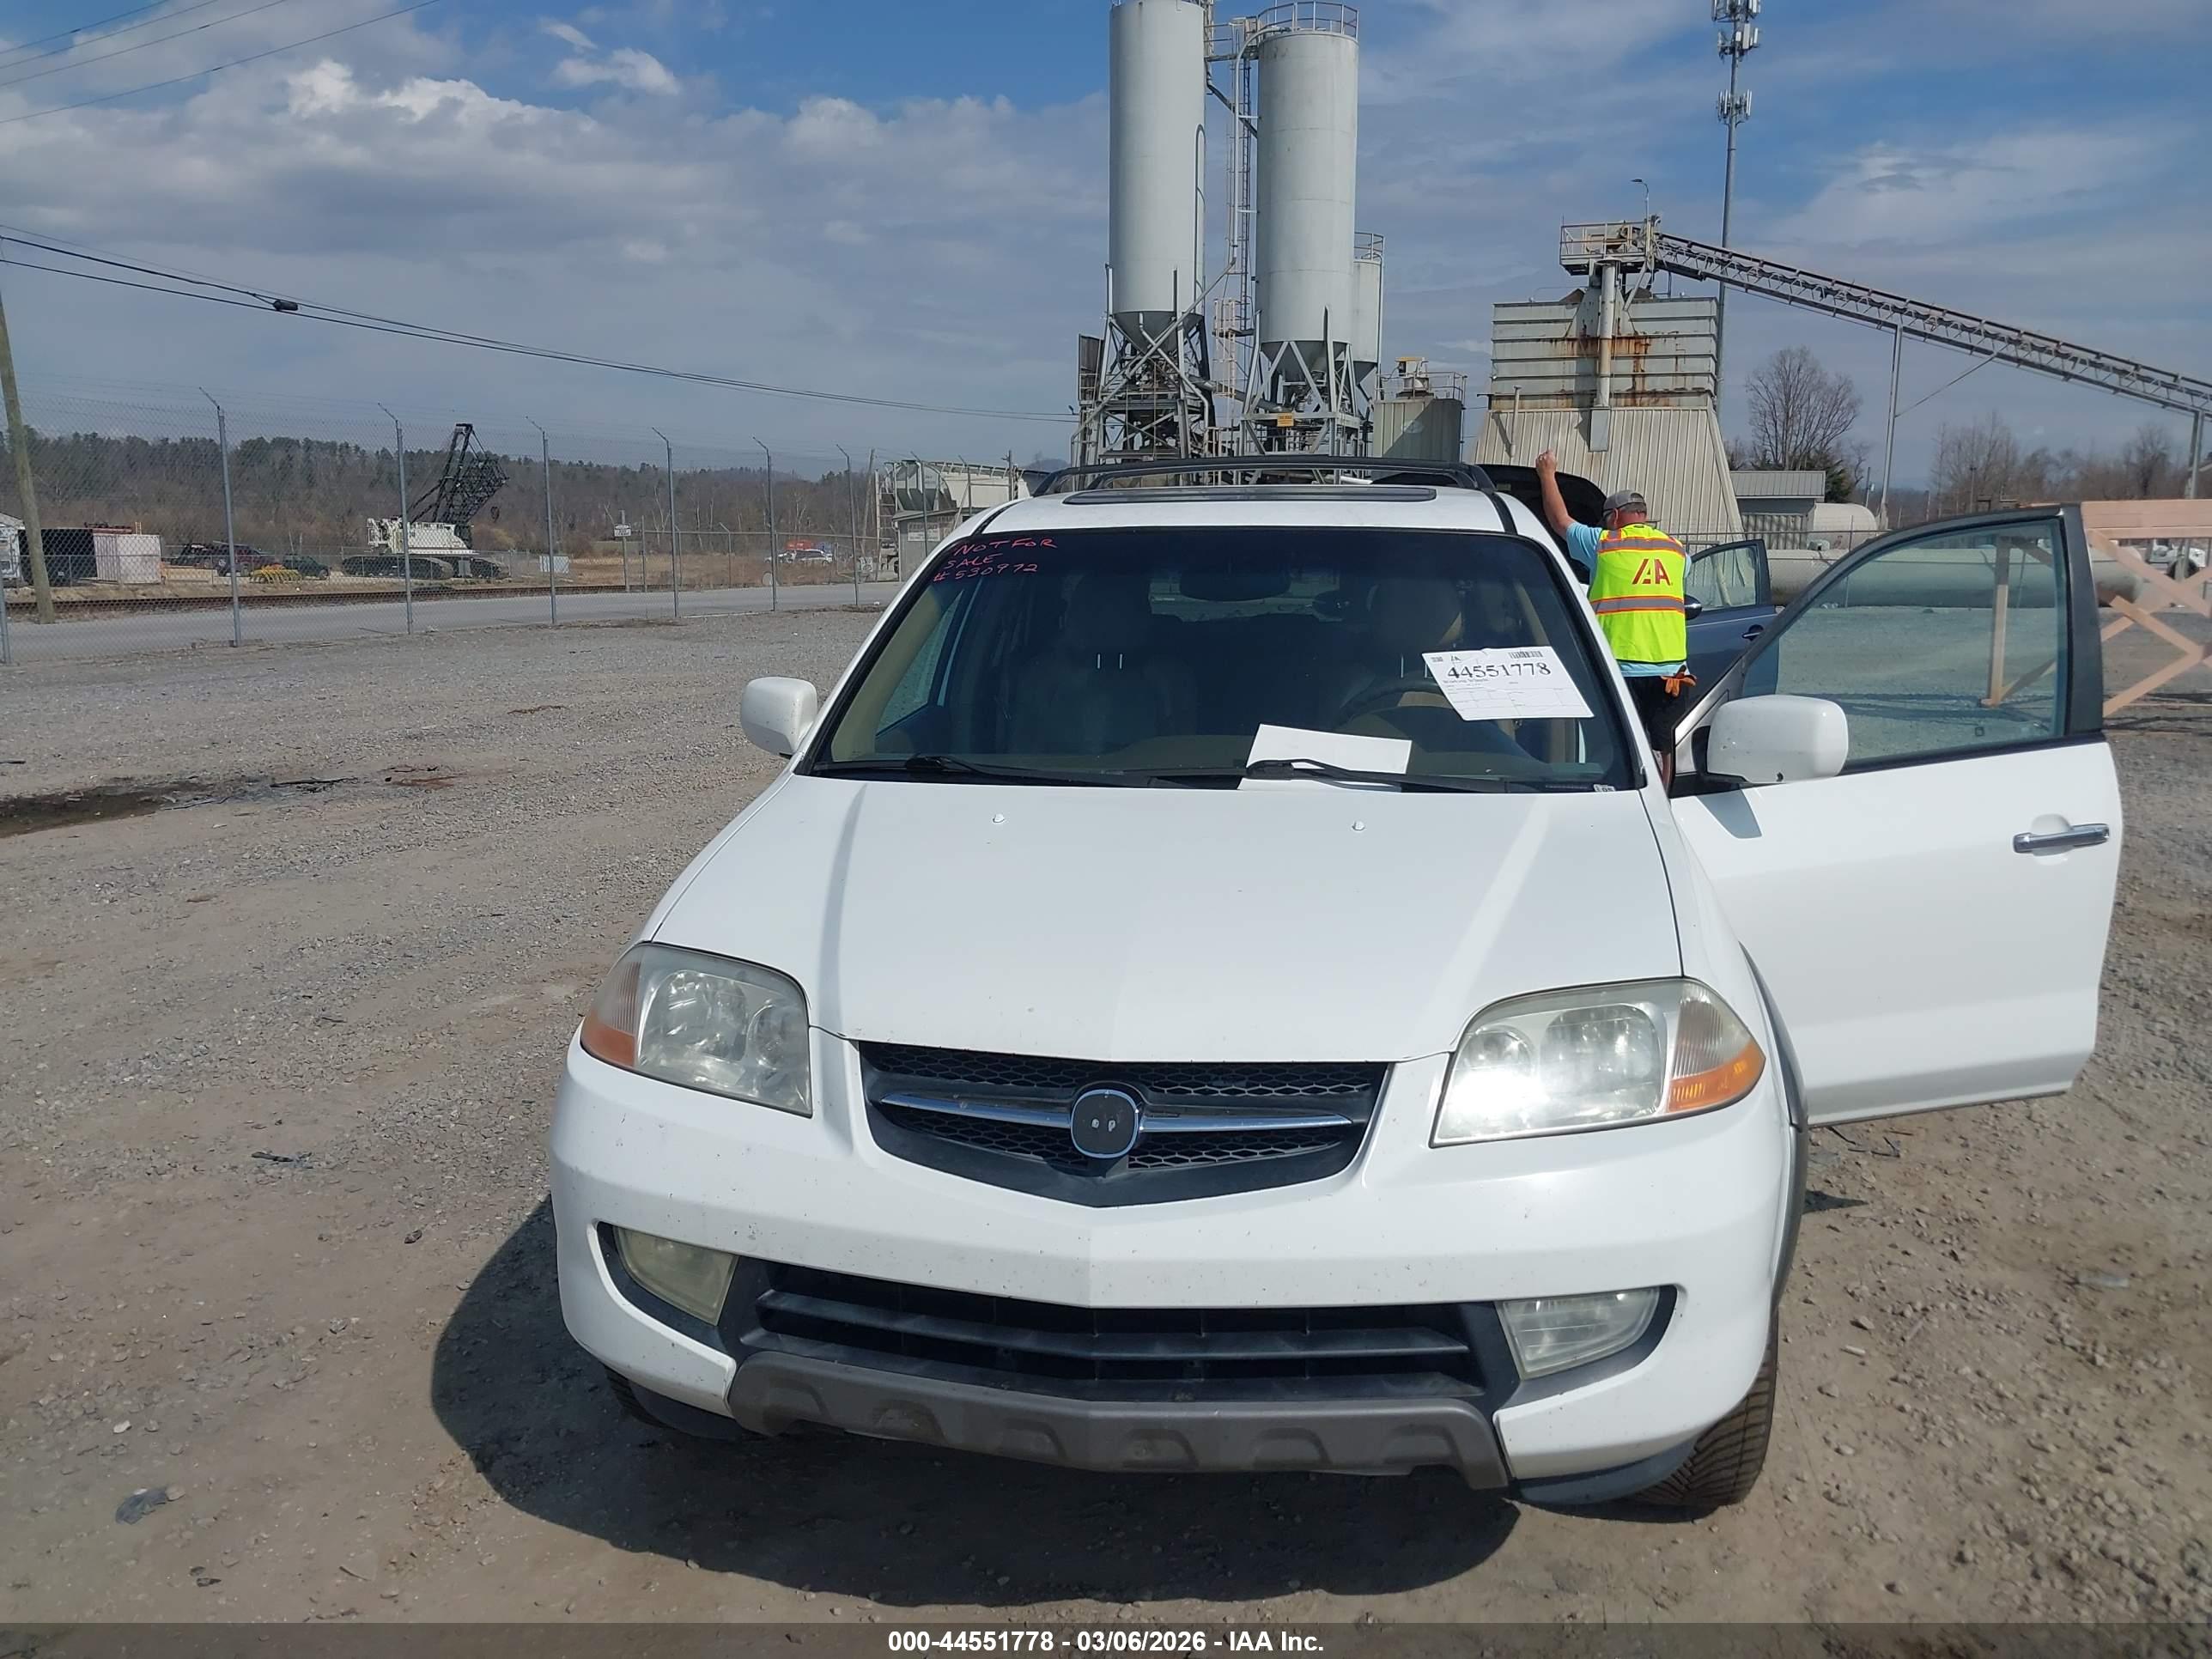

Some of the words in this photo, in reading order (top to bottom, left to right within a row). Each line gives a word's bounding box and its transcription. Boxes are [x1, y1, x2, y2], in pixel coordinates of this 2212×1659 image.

[954, 540, 1011, 556] NOT
[1012, 538, 1058, 549] FOR
[945, 552, 1003, 569] SALE
[1448, 662, 1552, 678] 44551778
